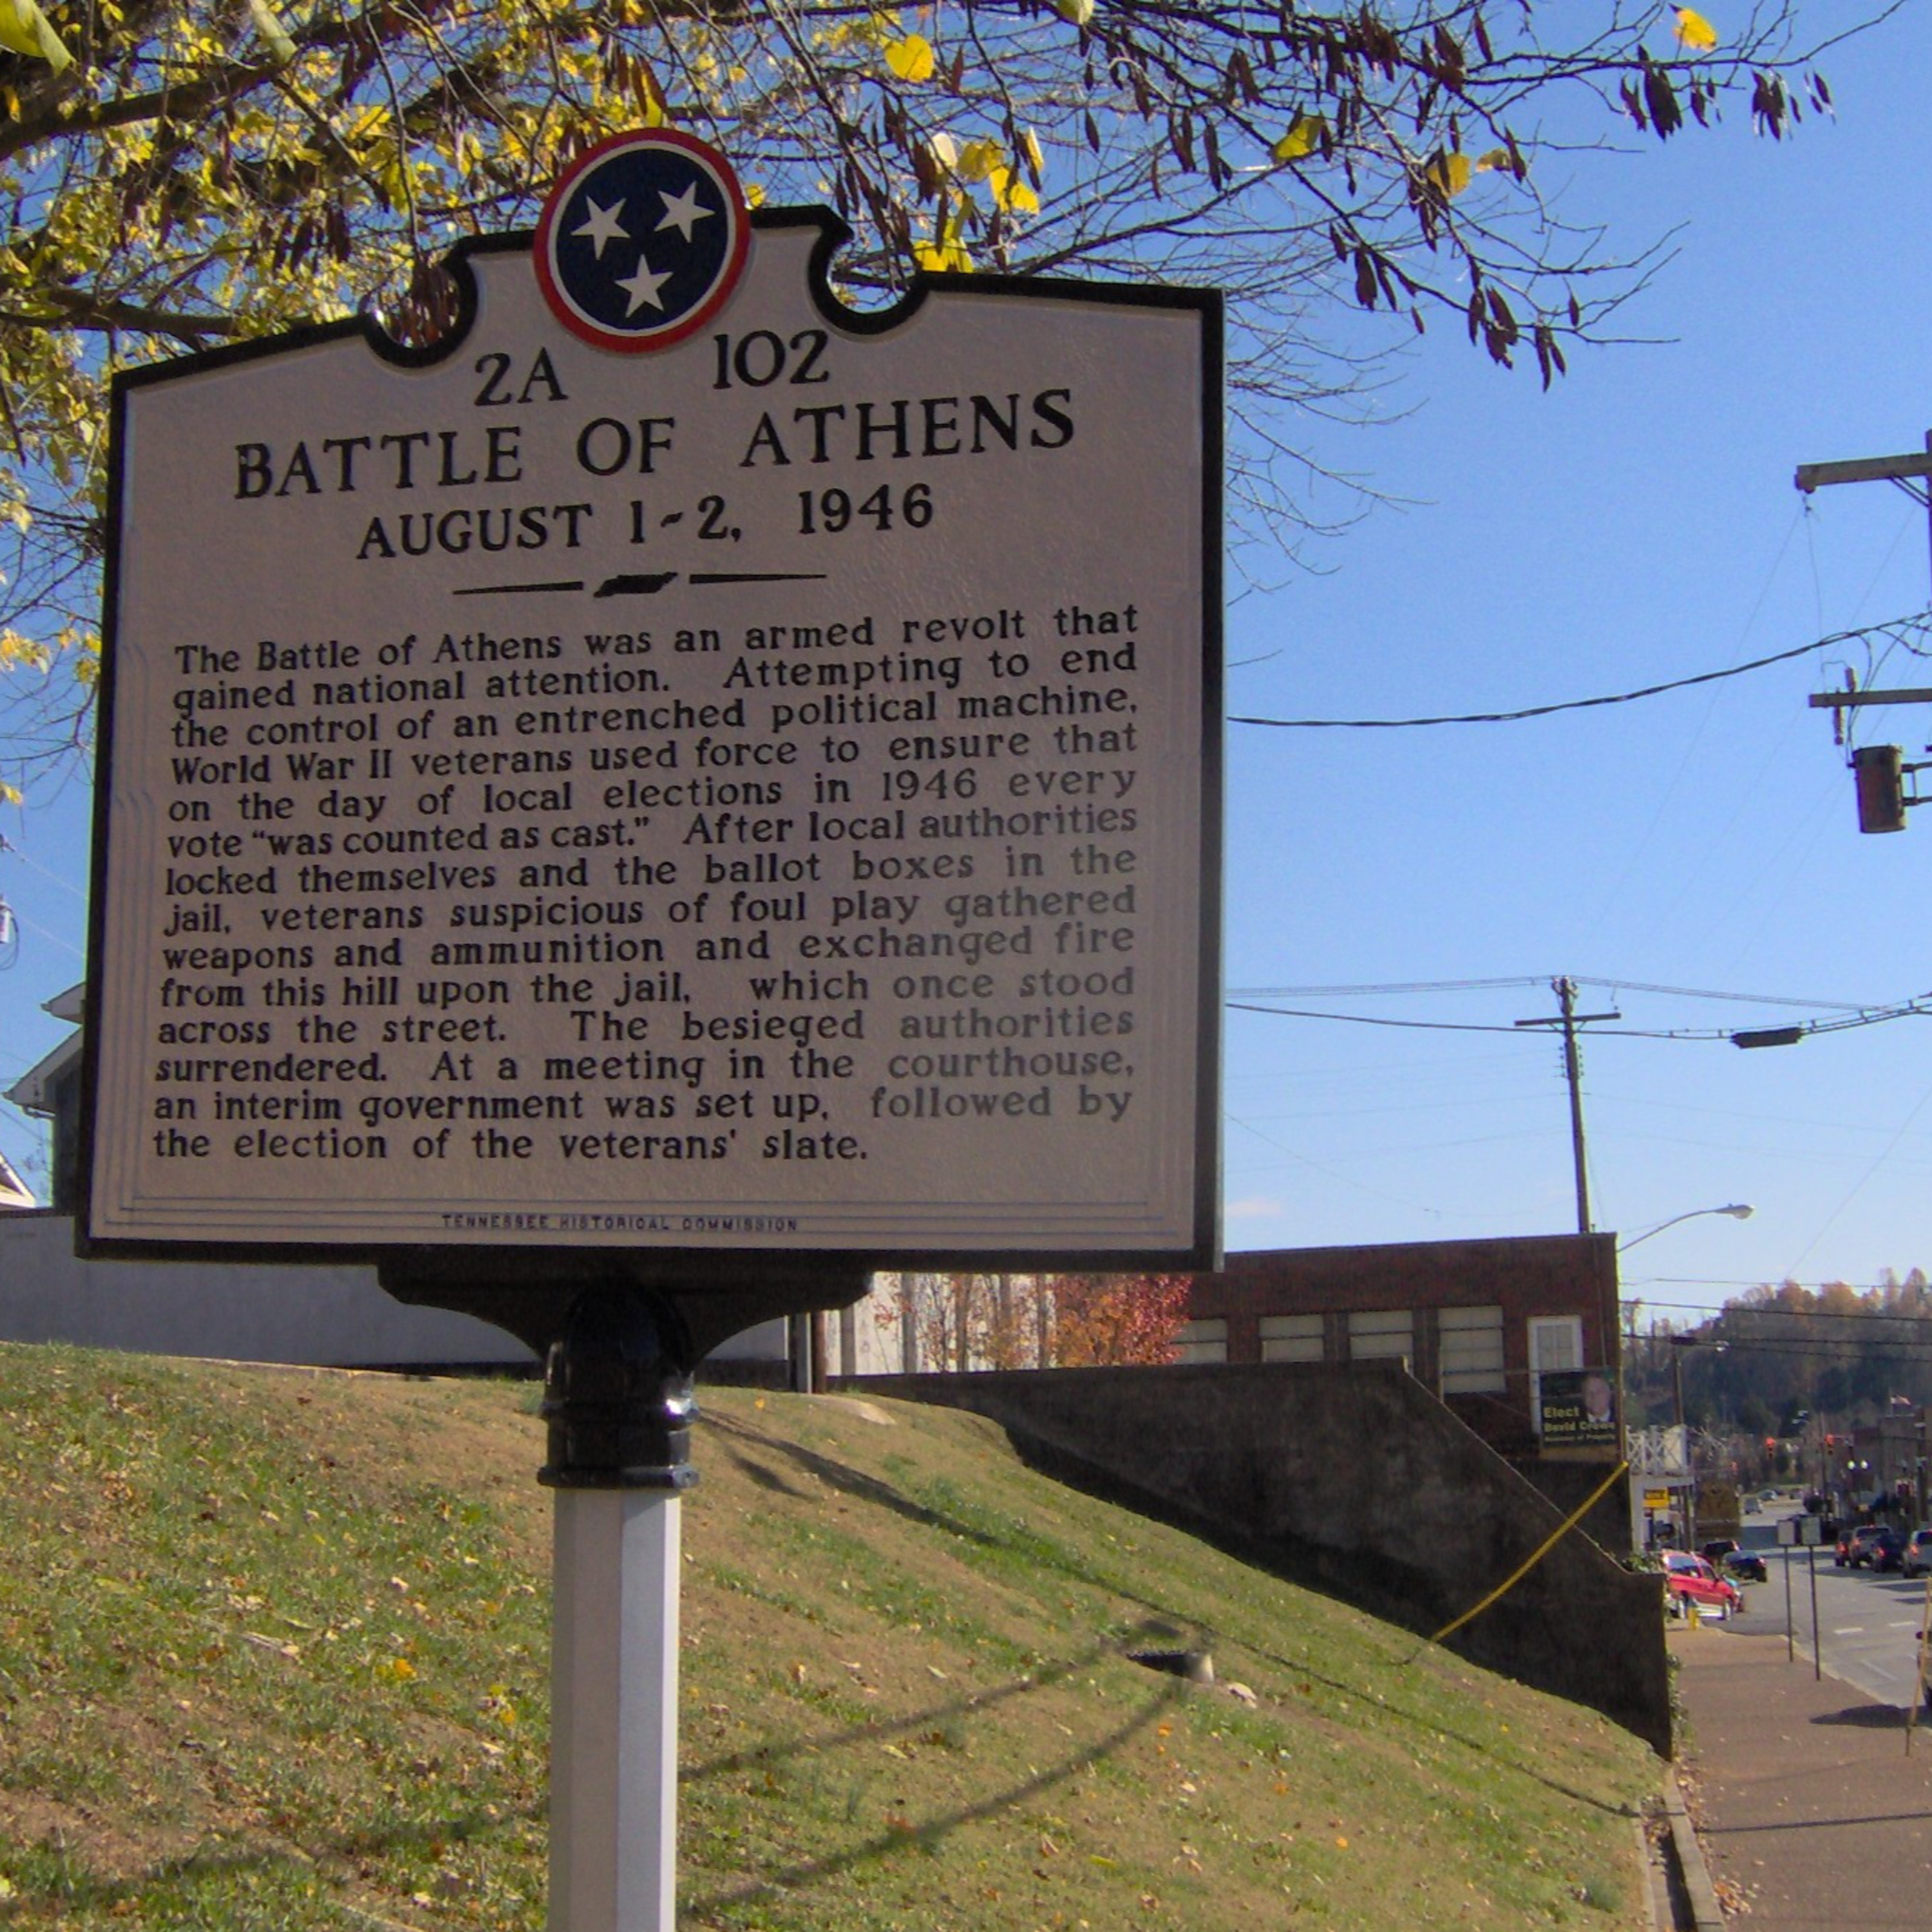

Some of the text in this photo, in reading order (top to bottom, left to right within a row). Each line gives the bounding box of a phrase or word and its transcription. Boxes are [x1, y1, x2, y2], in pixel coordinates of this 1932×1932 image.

[474, 329, 830, 407] 2A 102
[234, 388, 1074, 500] BATTLE OF ATHENS
[355, 483, 933, 560] AUGUST 1-2, 1946
[175, 605, 1137, 674] The Battle of Athens was an armed revolt that
[173, 642, 1136, 721] gained national attention. Attempting to end
[171, 685, 1136, 747] the control of an entrenched political machine,
[172, 723, 1136, 784] World War II veterans used force to ensure that
[169, 768, 1135, 822] on the day of local elections in 1946 every
[168, 832, 242, 857] vote
[343, 823, 488, 853] counted
[500, 828, 538, 849] as
[683, 813, 793, 844] After
[810, 810, 904, 841] local
[920, 804, 1135, 837] authorities
[166, 845, 1135, 895] locked themselves and the ballot boxes in the
[164, 886, 1134, 936] jail, veterans suspicious of foul play gathered
[163, 923, 1133, 976] weapons and ammunition and exchanged fire
[162, 967, 1132, 1009] from this hill upon the jail, which once stood
[158, 1006, 1132, 1048] across the street. The besieged authorities
[156, 1047, 1132, 1088] surrendered. At a meeting in the courthouse,
[155, 1085, 1131, 1127] an interim government was set up, followed by
[153, 1128, 866, 1159] the election of the veterans' slate.
[441, 1215, 797, 1231] TENNESSEE HISTORICAL COMMISSION
[1544, 1406, 1580, 1418] Elect
